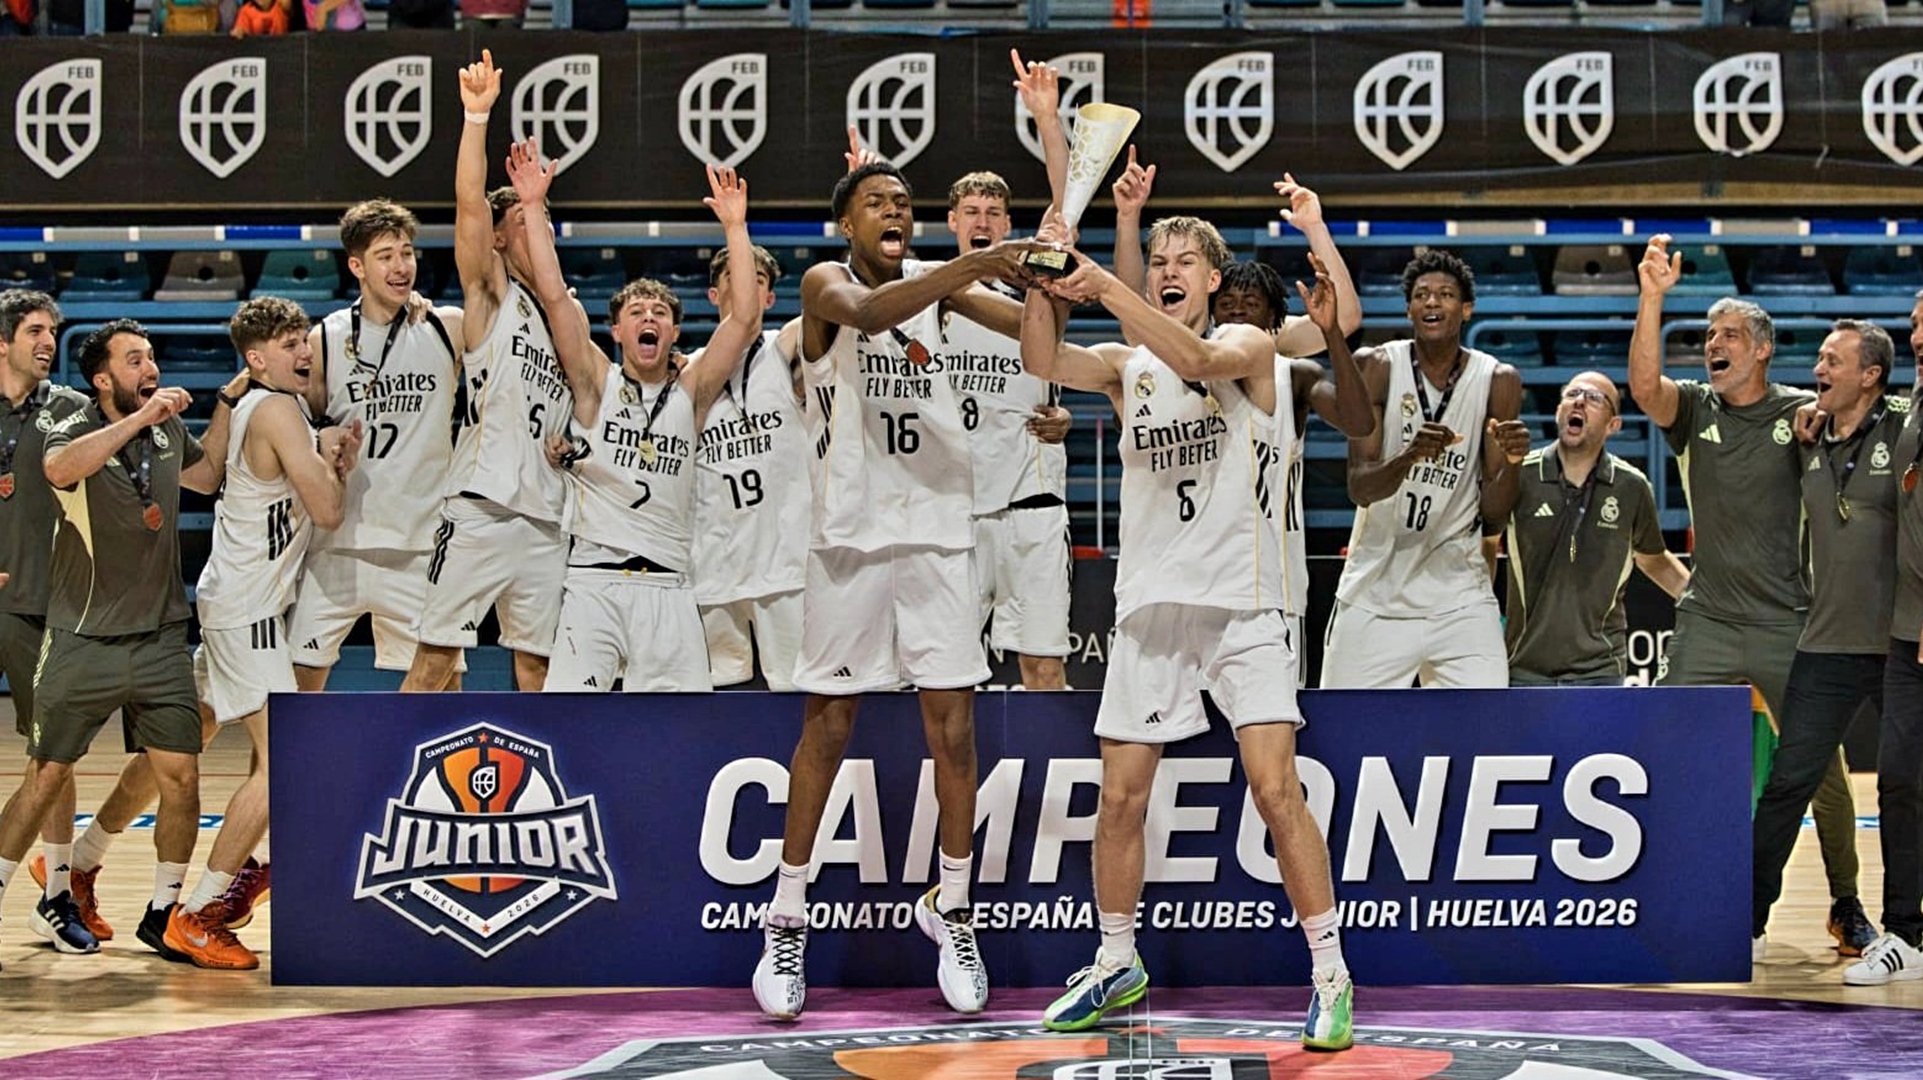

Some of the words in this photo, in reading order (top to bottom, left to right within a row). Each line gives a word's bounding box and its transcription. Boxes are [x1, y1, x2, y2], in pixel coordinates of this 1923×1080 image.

[68, 66, 94, 78] FEB
[232, 65, 258, 78] FEB
[397, 63, 424, 76] FEB
[564, 62, 591, 75] FEB
[732, 61, 759, 74] FEB
[900, 61, 928, 74] FEB
[1069, 61, 1096, 73] FEB
[1238, 60, 1265, 72] FEB
[1407, 60, 1433, 71] FEB
[1577, 60, 1603, 71] FEB
[1745, 61, 1772, 72] FEB
[945, 350, 1021, 375] mirates
[866, 377, 889, 397] FLY
[894, 378, 931, 399] BETER
[961, 374, 1006, 394] BETTER
[962, 397, 979, 431] 8
[367, 423, 398, 459] 17
[603, 420, 689, 457] Emrates
[696, 410, 783, 452] mirates
[880, 411, 919, 454] 16
[614, 448, 637, 468] FLY
[705, 444, 722, 464] FLY
[727, 434, 772, 459] BETTER
[1151, 449, 1174, 472] FLY
[1179, 439, 1218, 466] BETER
[629, 480, 651, 509] 7
[722, 468, 764, 509] 19
[1406, 491, 1431, 531] 18
[425, 736, 474, 759] CAMPEONATO
[494, 736, 505, 745] DE
[508, 742, 539, 758] ESPAÑA
[699, 753, 1648, 885] CAMPEONES
[423, 888, 471, 921] HUELVA
[507, 894, 539, 917] 2026
[701, 902, 912, 929] CAMONATO
[973, 896, 1093, 929] ESPAÑA
[1152, 901, 1275, 928] CLUBES
[1281, 901, 1400, 928] JNIOR
[1427, 900, 1547, 927] HUELVA
[1553, 898, 1638, 926] 2026
